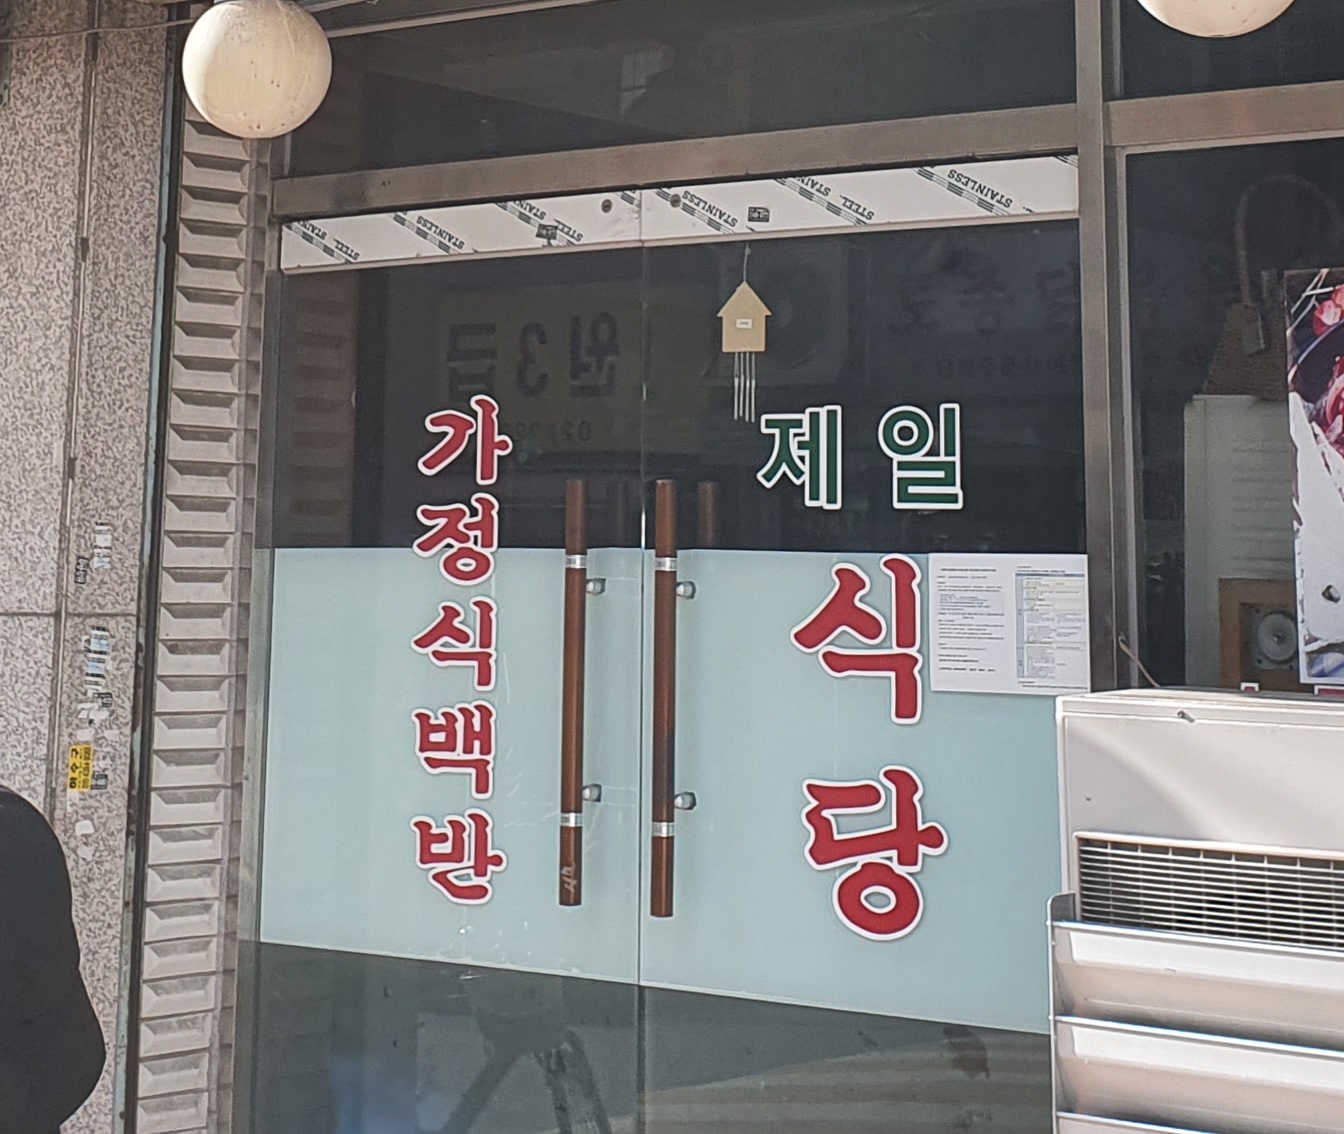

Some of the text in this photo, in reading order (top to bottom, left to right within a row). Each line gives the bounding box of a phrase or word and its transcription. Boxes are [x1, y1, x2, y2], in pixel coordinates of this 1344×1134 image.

[681, 189, 739, 229] STAINLESS
[947, 168, 1014, 210] STAINLESS
[415, 214, 466, 250] STAINLESS
[757, 402, 964, 511] 제일
[409, 394, 513, 906] 가정식백반
